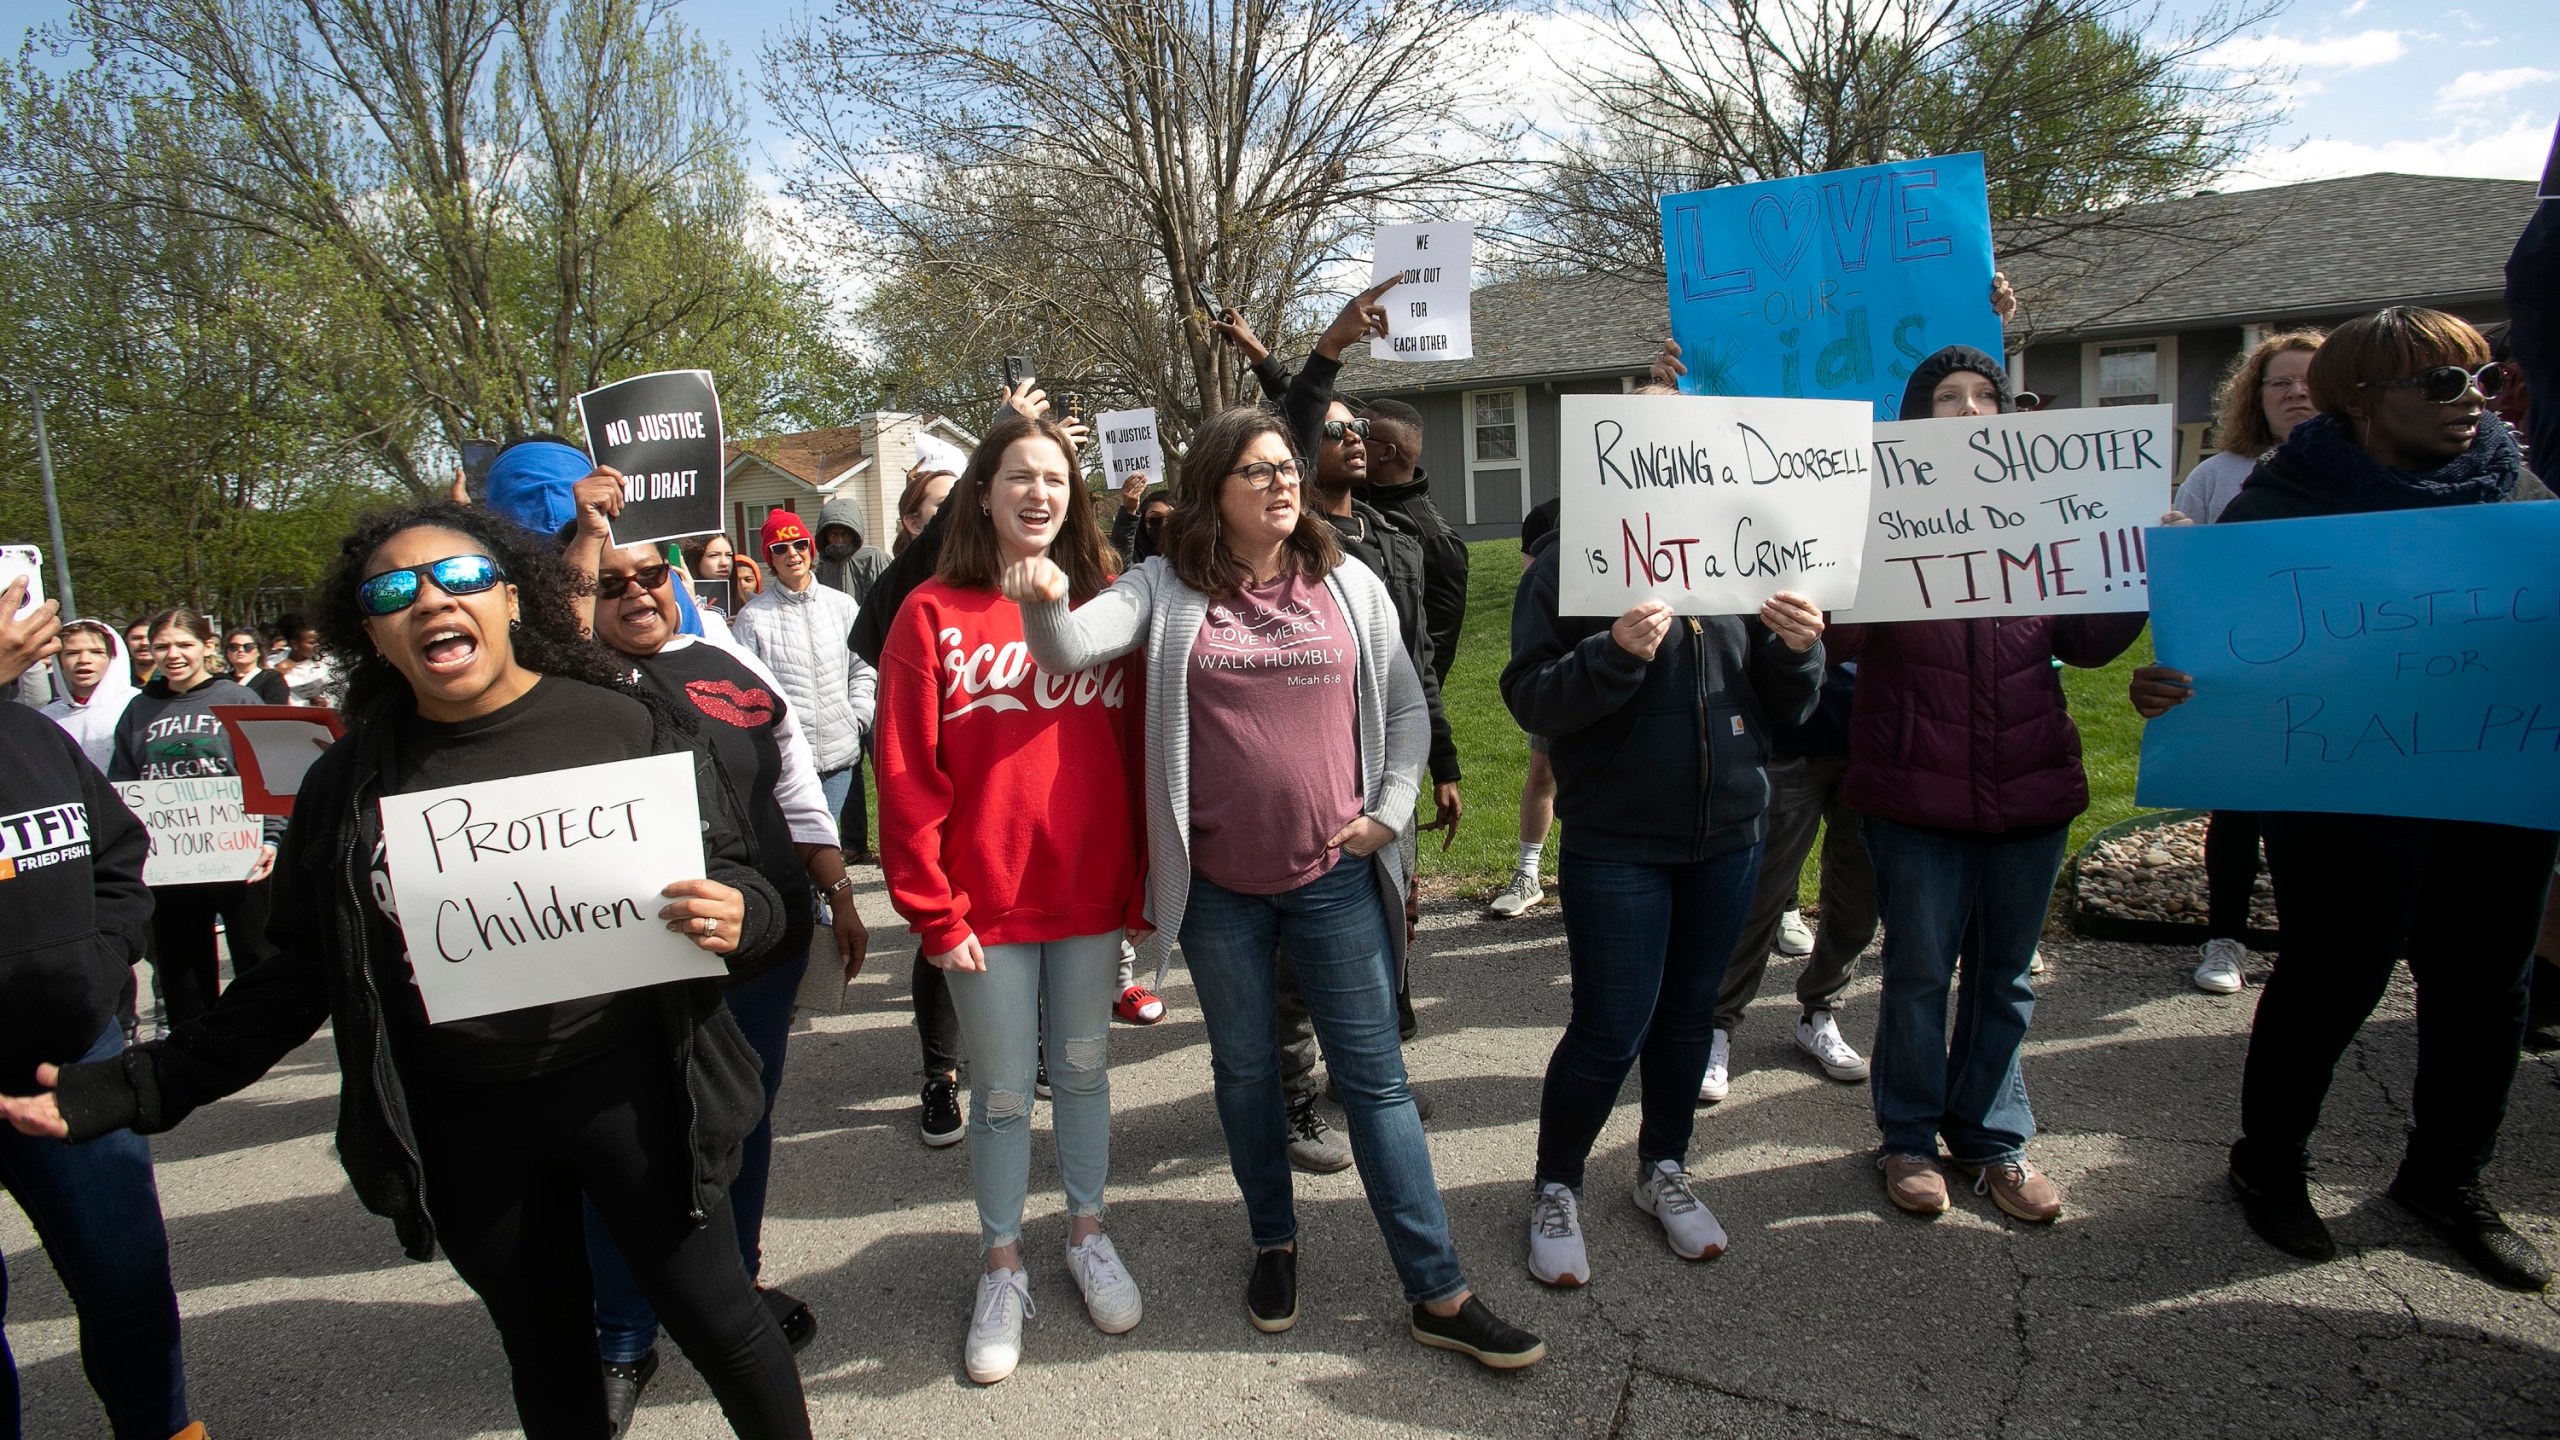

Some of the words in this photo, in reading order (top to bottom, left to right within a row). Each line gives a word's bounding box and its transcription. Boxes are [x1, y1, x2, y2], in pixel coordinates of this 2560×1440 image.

[1416, 235, 1429, 250] WE
[1424, 267, 1441, 283] OUT
[1411, 302, 1427, 317] FOR
[1394, 337, 1417, 352] EACH
[1420, 335, 1447, 351] OTHER
[605, 419, 632, 447] NO
[637, 411, 706, 442] JUSTICE
[1105, 430, 1116, 444] NO
[1119, 426, 1152, 443] JUSTICE
[1113, 459, 1123, 472] NO
[1125, 456, 1150, 471] PEACE
[1595, 420, 1714, 489] RINGING
[1722, 466, 1738, 484] a
[1737, 422, 1868, 484] DOORBELL
[1873, 440, 1937, 488] The
[1968, 427, 2162, 484] SHOOTER
[624, 474, 645, 502] NO
[650, 470, 698, 500] DRAFT
[1879, 508, 1975, 540] Should
[1980, 505, 2025, 529] Do
[2040, 494, 2108, 524] The
[776, 525, 800, 540] KC
[1622, 512, 1700, 590] NOT
[1705, 554, 1725, 577] a
[1213, 605, 1246, 623] ACT
[2229, 566, 2560, 665] JUSTIC
[1211, 628, 1258, 645] LOVE
[1266, 619, 1326, 643] MERCY
[1198, 654, 1256, 669] WALK
[1264, 649, 1343, 668] HUMBLY
[2395, 650, 2489, 681] FOR
[1288, 675, 1319, 686] Micah
[1323, 674, 1341, 684] 6:8
[146, 714, 222, 742] STALEY
[140, 757, 228, 780] FALCONS
[156, 780, 241, 805] CHILDHO
[168, 832, 214, 855] YOUR
[423, 798, 645, 873] PROTECT
[17, 851, 61, 872] FRIED
[60, 845, 85, 862] FISH
[436, 881, 645, 962] Children
